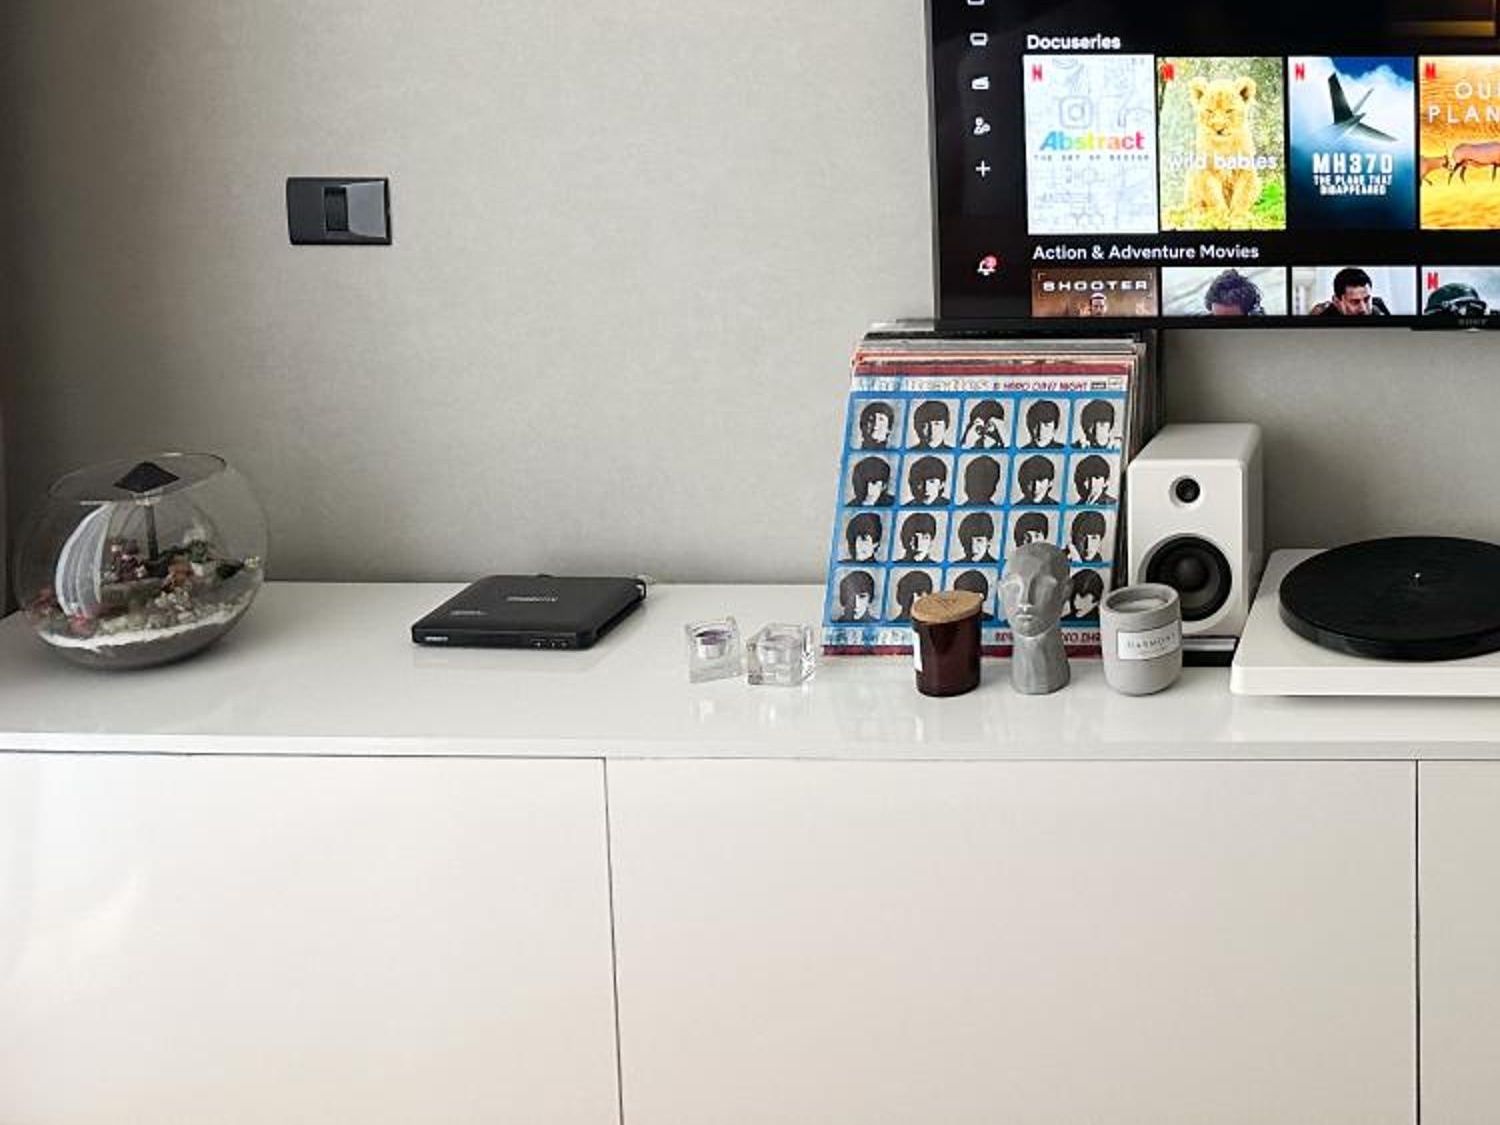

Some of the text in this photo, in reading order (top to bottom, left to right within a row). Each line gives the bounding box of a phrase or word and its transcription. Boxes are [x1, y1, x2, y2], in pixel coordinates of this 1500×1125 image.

[1027, 34, 1121, 50] Docuseries
[1040, 131, 1145, 151] Abstract
[1313, 153, 1393, 174] MH370
[1033, 244, 1260, 260] Action & Adventure Movies
[1043, 280, 1148, 292] SHOOTER
